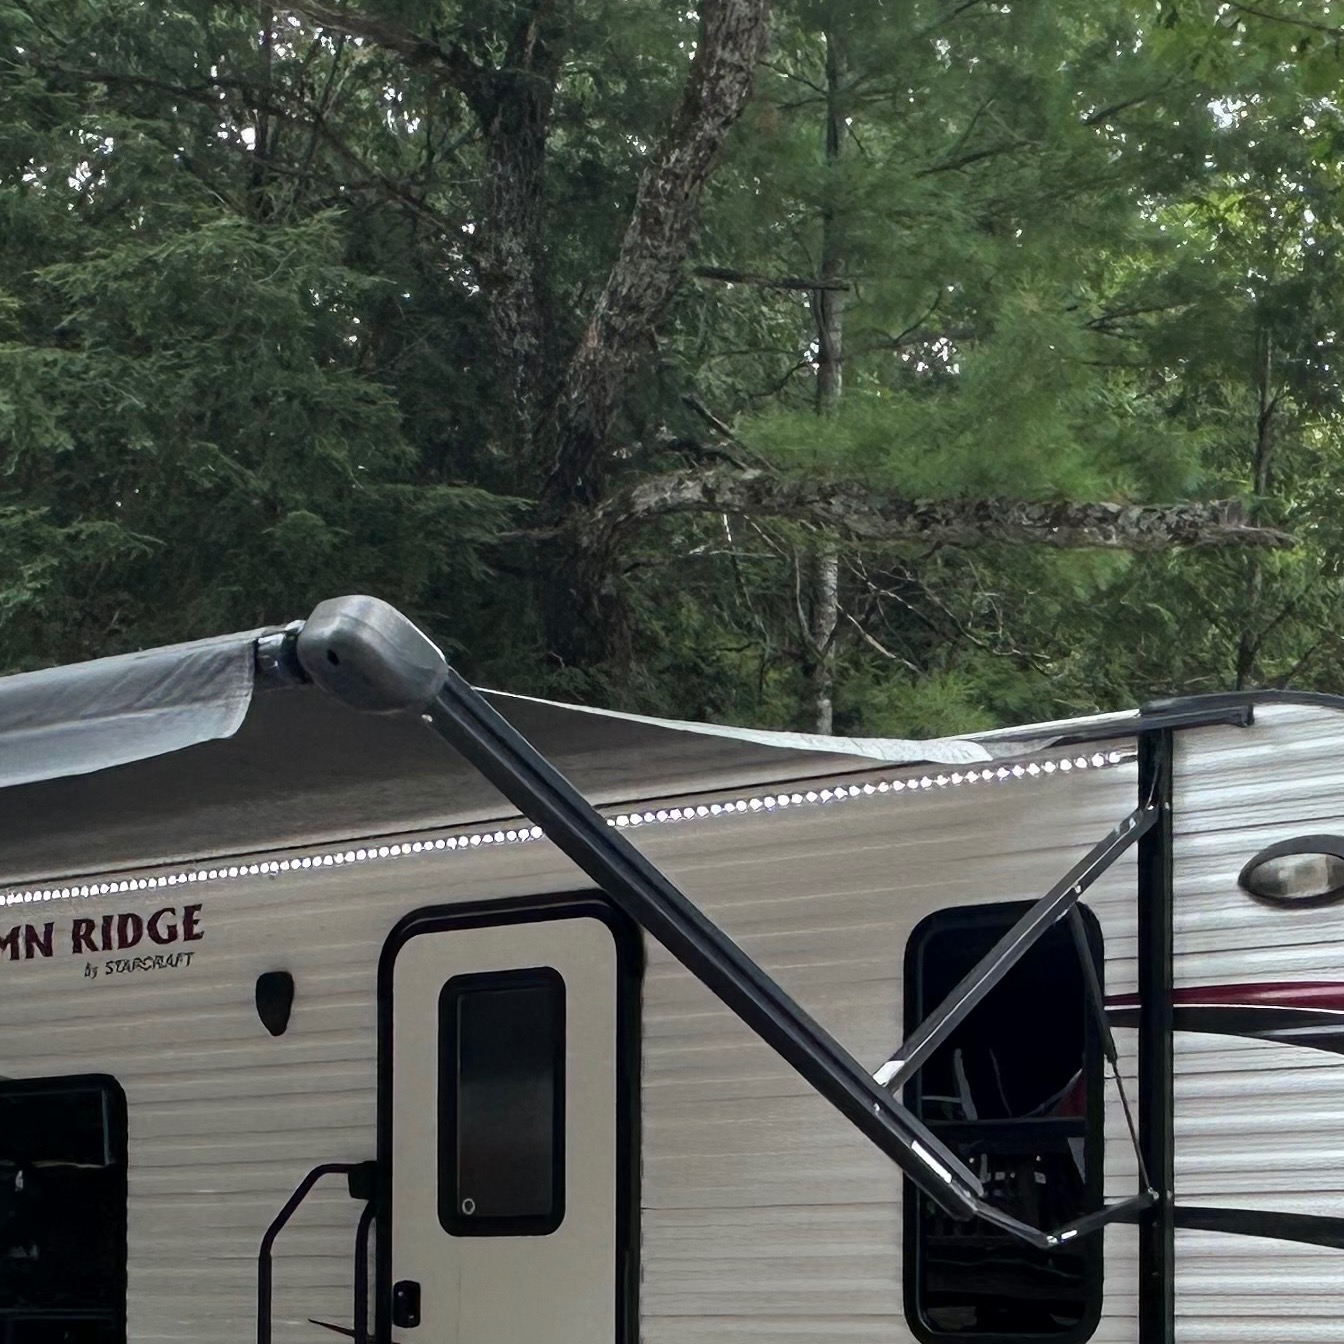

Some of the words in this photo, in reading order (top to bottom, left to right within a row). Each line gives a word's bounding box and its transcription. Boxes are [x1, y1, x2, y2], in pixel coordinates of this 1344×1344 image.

[71, 903, 205, 955] RIDGE
[84, 961, 98, 979] by
[105, 951, 195, 975] STARCRAFT
